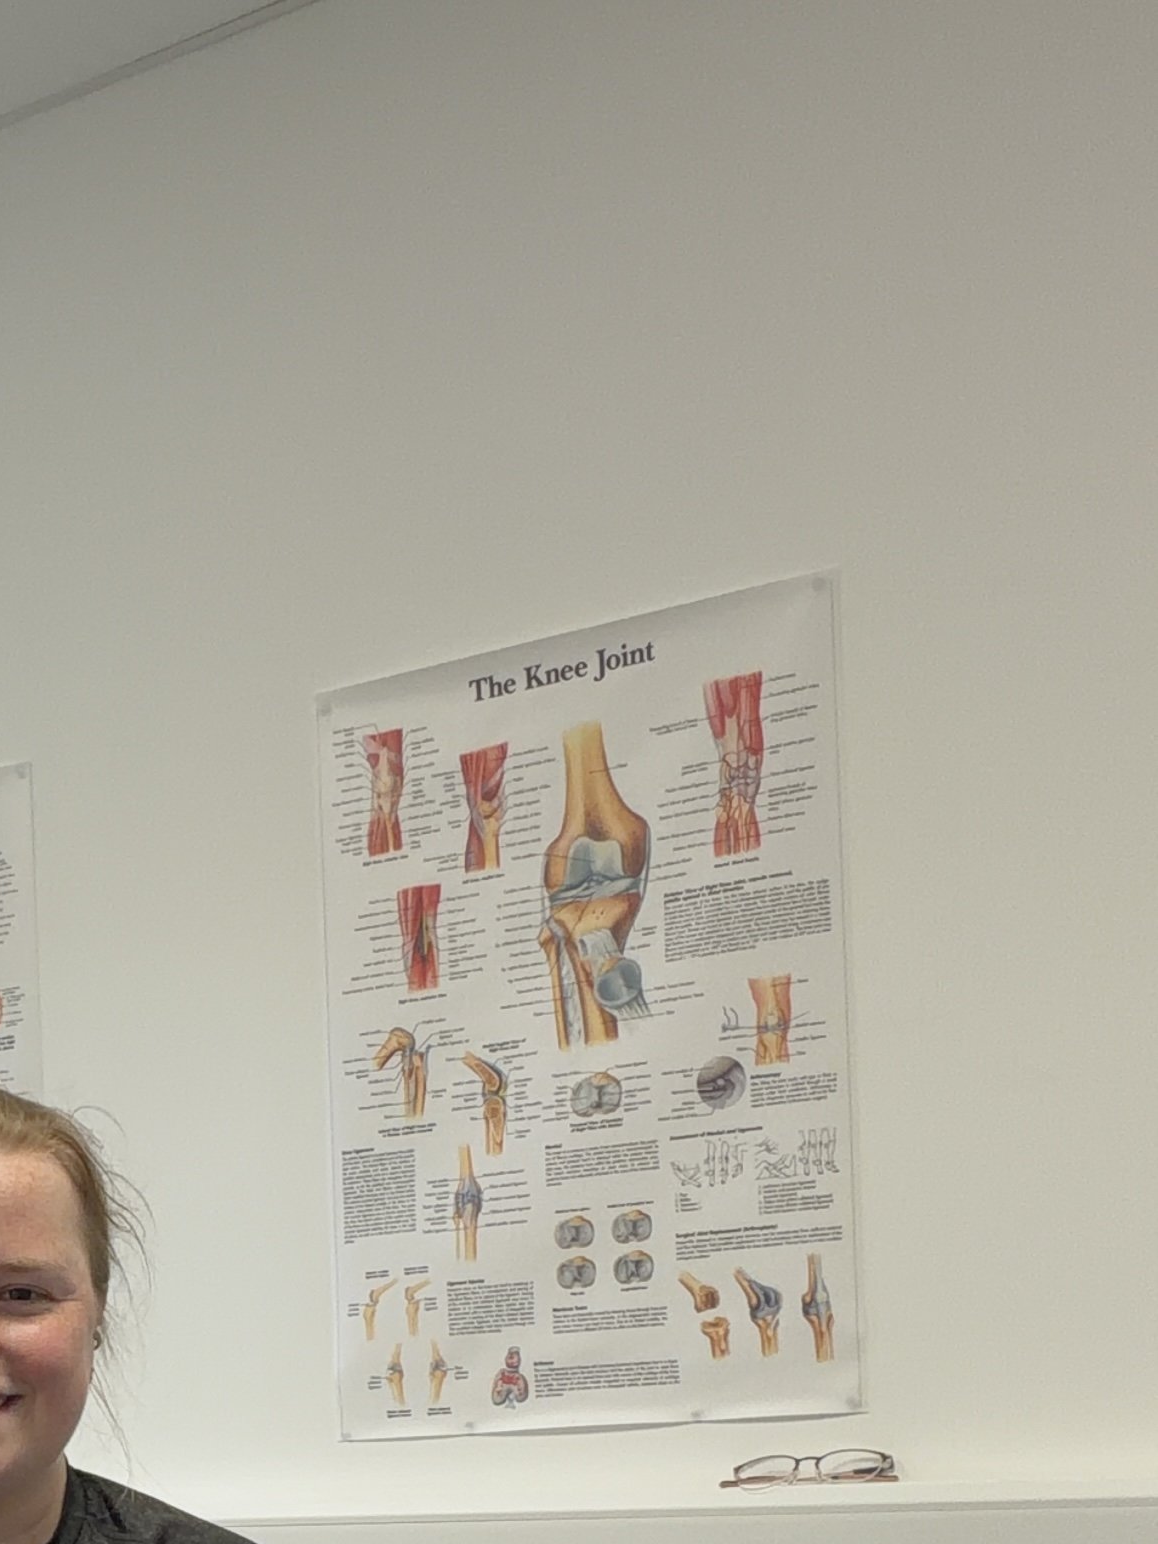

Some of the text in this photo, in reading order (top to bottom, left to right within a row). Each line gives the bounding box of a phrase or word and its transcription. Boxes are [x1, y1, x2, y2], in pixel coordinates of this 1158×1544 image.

[468, 641, 655, 702] The Knee Joint
